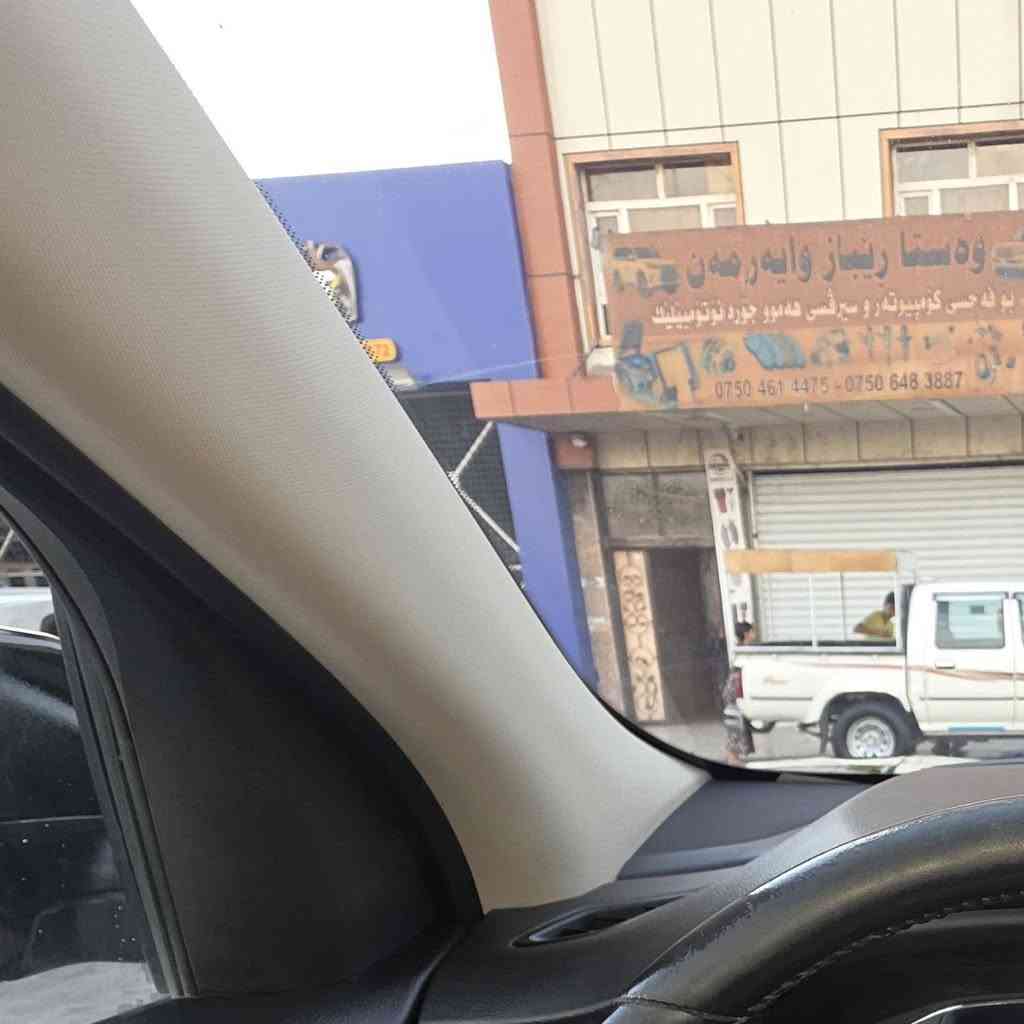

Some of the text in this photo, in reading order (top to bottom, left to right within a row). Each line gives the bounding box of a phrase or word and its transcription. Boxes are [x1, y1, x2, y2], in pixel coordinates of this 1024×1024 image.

[714, 379, 751, 399] 0750
[757, 378, 785, 397] 461
[791, 375, 829, 394] 4475
[845, 374, 884, 393] 0750
[888, 372, 919, 392] 648
[924, 370, 963, 390] 3887
